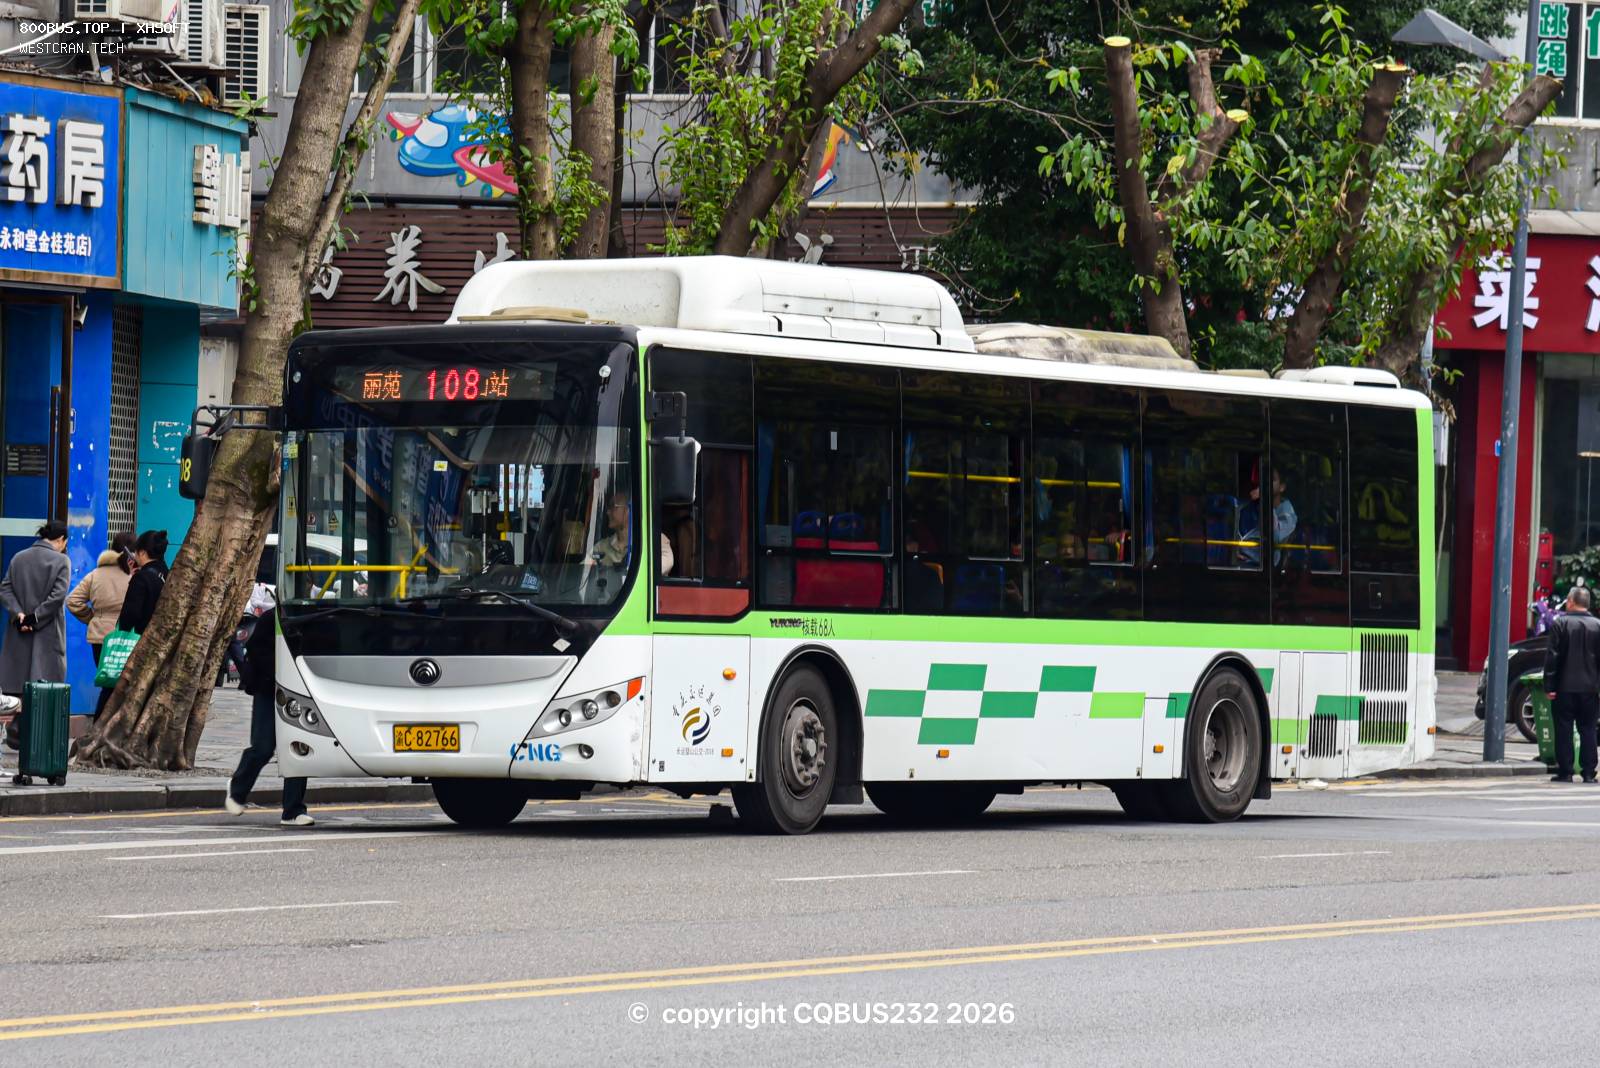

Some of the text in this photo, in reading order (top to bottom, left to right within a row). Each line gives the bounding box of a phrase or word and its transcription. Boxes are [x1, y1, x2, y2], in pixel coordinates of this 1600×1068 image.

[1536, 2, 1570, 77] 跳绳
[0, 112, 105, 208] 药房
[362, 370, 403, 400] 丽苑
[427, 368, 480, 400] 108
[509, 742, 563, 763] CNG
